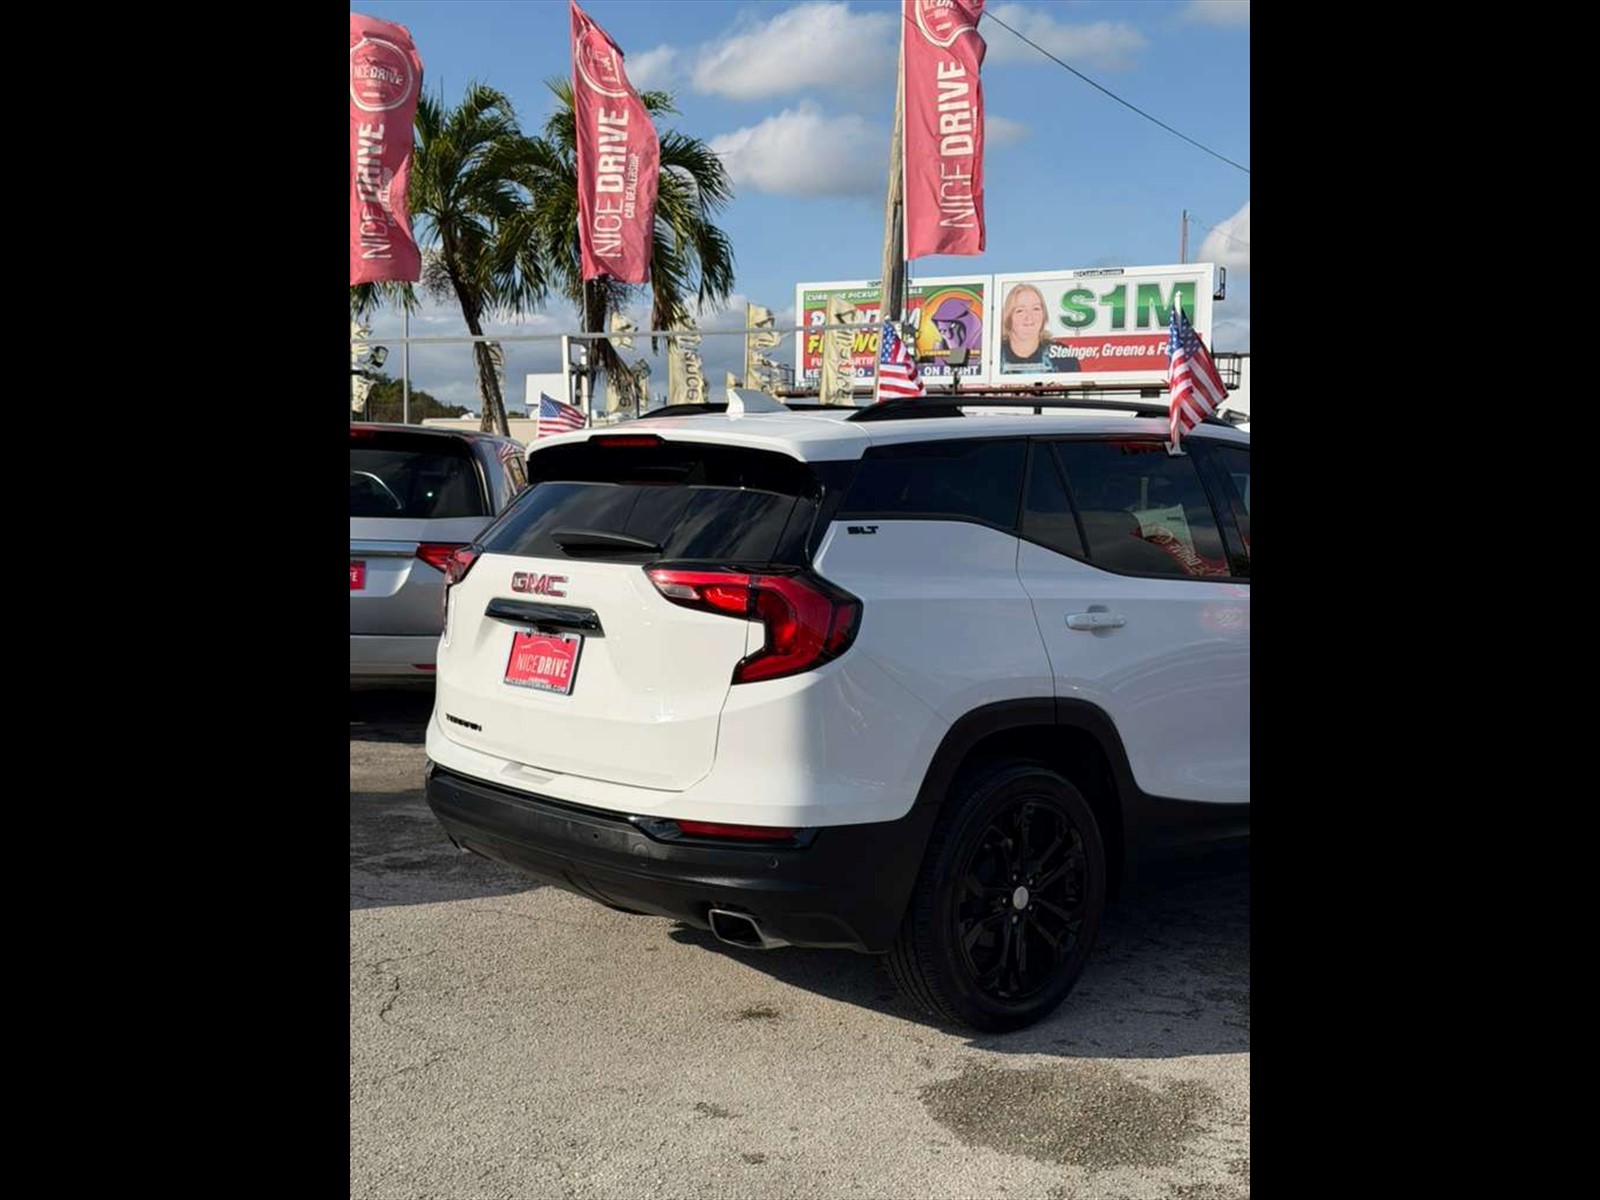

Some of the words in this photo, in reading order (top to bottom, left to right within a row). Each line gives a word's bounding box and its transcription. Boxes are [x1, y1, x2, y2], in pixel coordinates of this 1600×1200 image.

[937, 60, 974, 157] DRIVE
[596, 106, 629, 193] DRIVE
[359, 206, 392, 260] NICE
[592, 198, 624, 258] NICE
[1058, 281, 1196, 335] $1M
[924, 366, 940, 376] ON
[1048, 345, 1100, 360] Steinger,
[1101, 343, 1145, 357] Greene
[1146, 346, 1156, 355] &
[511, 571, 569, 598] GMC
